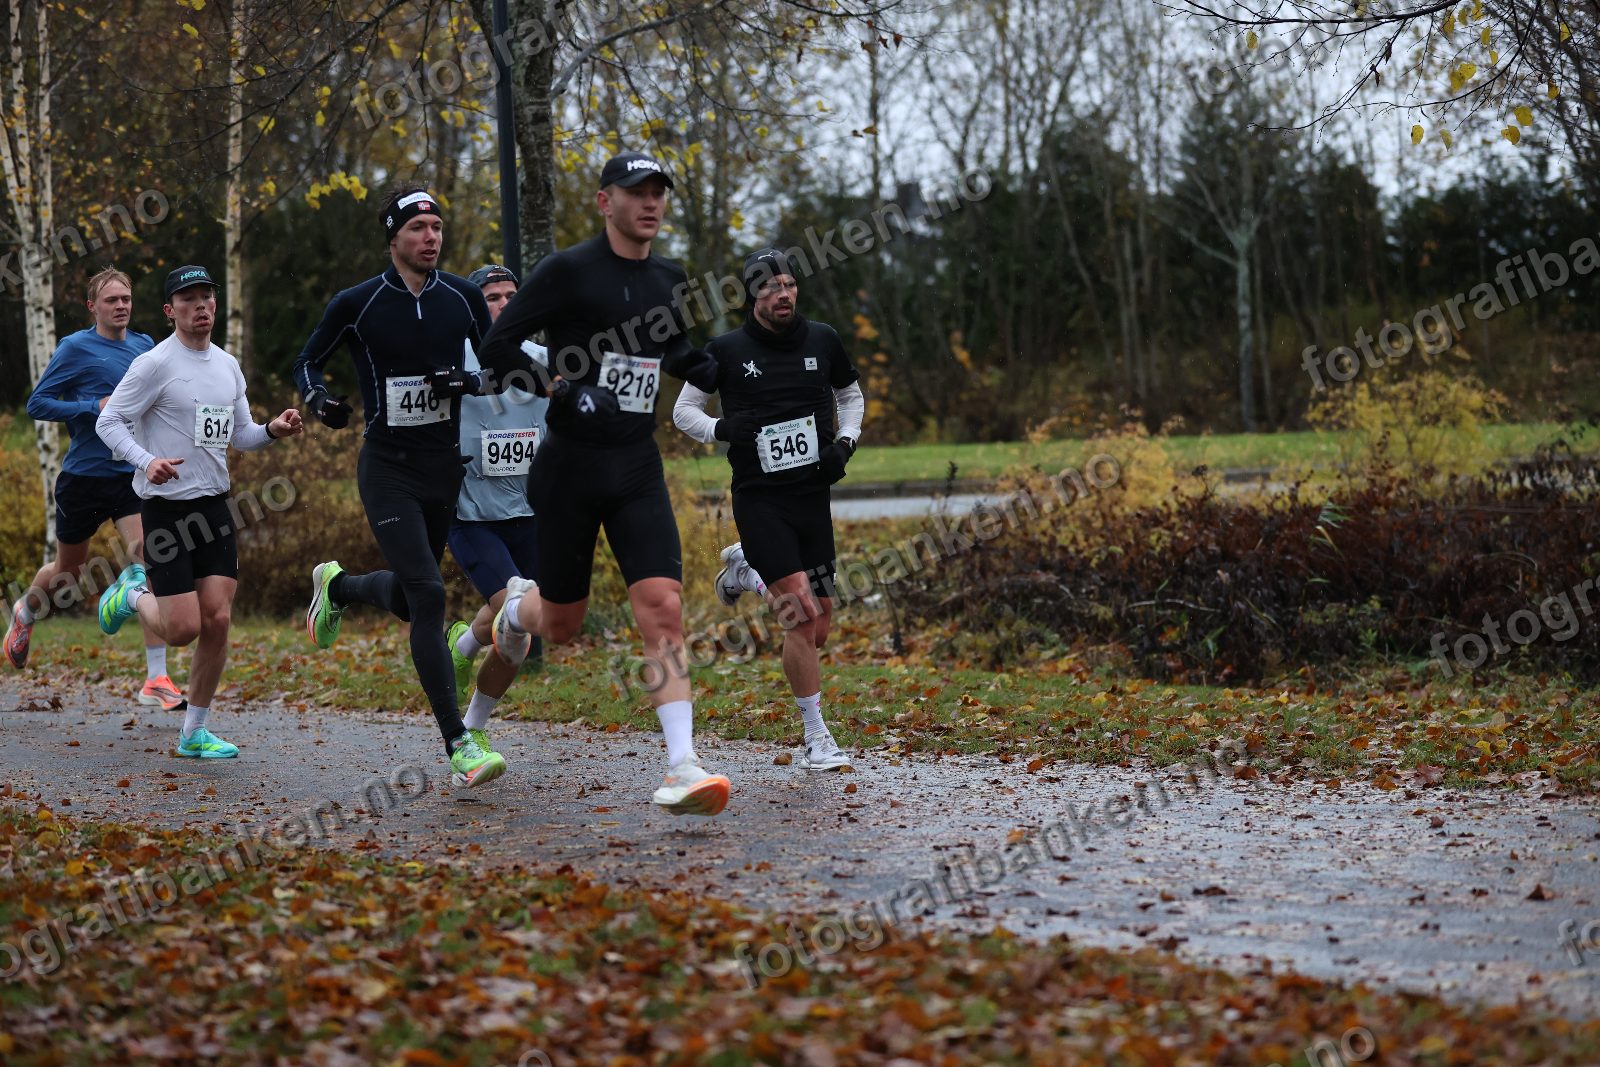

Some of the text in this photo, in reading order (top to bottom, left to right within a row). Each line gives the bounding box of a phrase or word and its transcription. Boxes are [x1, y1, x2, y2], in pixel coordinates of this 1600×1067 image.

[627, 160, 661, 172] HOKA
[181, 270, 207, 281] HOKA
[607, 368, 655, 399] 9218
[204, 418, 229, 438] 614
[487, 431, 536, 440] NORGESTESTEN
[487, 440, 534, 465] 9494
[770, 433, 808, 461] 546
